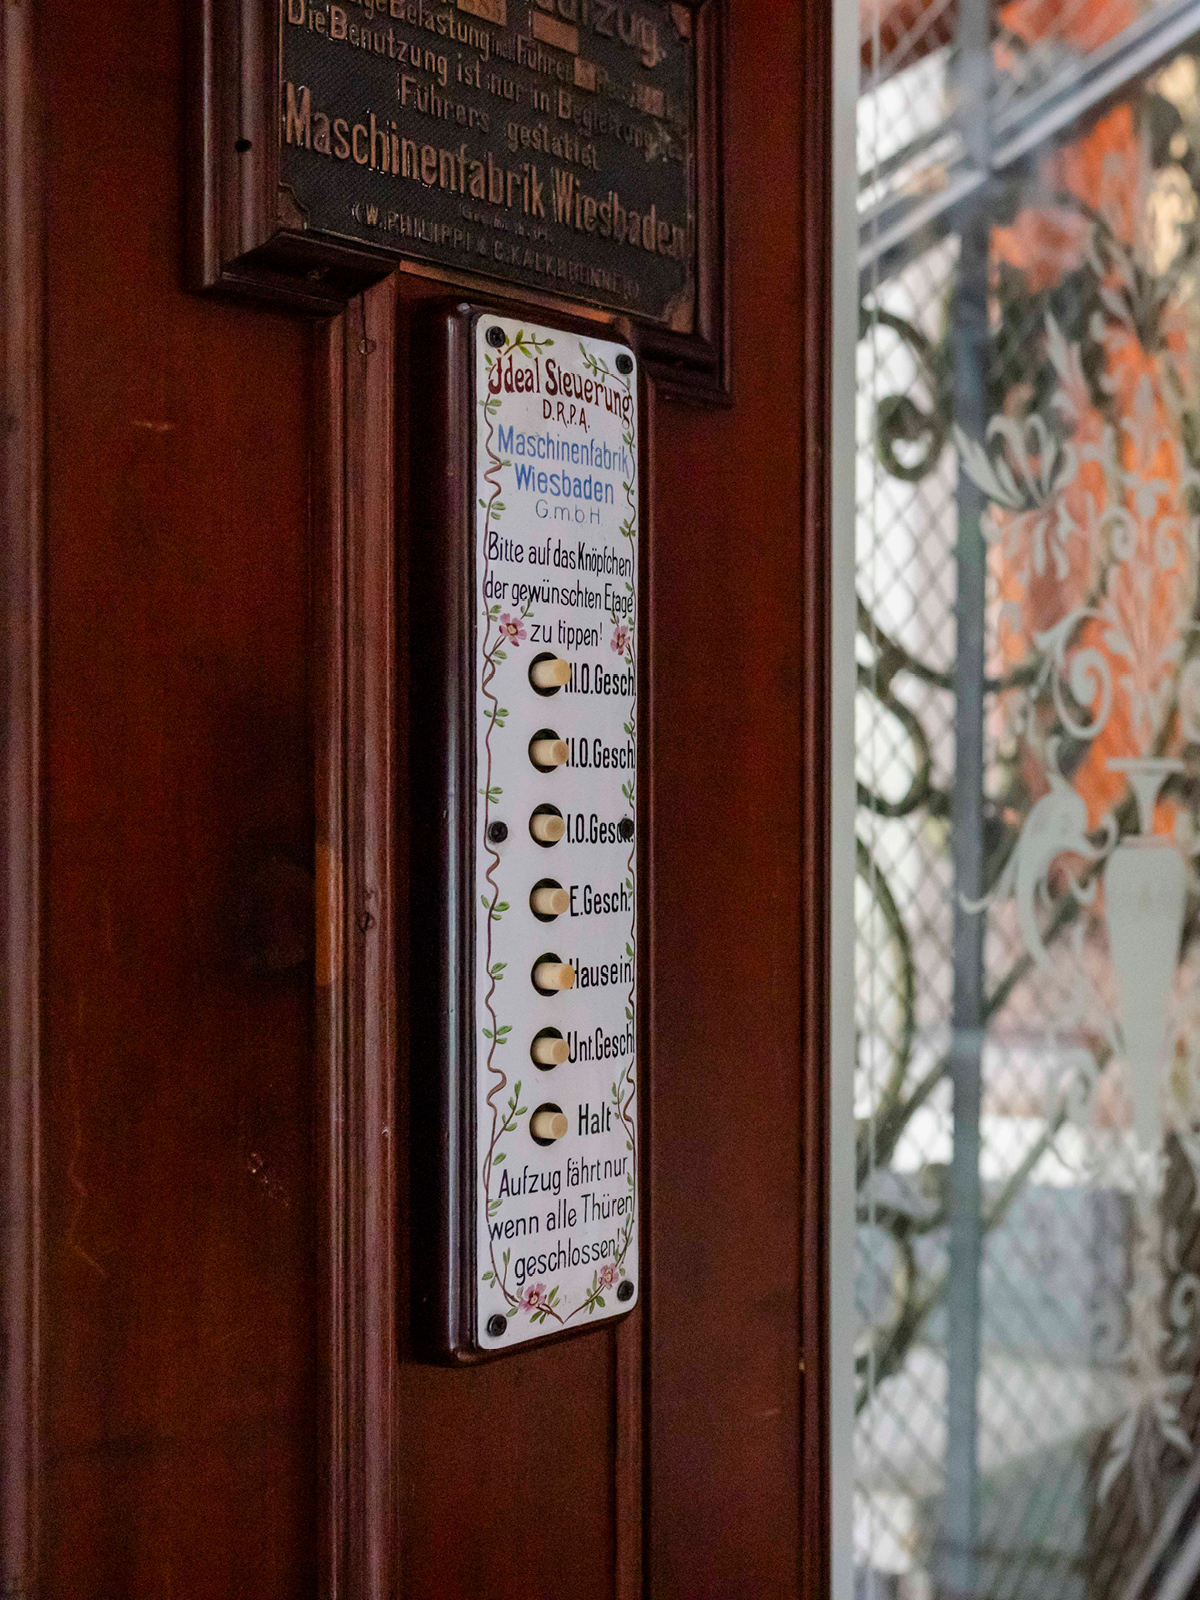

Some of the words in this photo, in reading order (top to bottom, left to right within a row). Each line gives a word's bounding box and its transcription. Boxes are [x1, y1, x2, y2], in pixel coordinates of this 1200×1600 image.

[330, 4, 448, 88] Benutzung
[457, 52, 481, 89] ist
[488, 73, 522, 102] nur
[533, 87, 550, 114] in
[399, 74, 489, 134] Führers
[285, 81, 546, 219] Maschinenfabrik
[552, 165, 686, 258] Wiesbaden
[488, 353, 540, 395] Ideal
[545, 358, 633, 430] Steuerung
[542, 398, 591, 434] D.R.P.A.
[498, 423, 630, 479] Maschinenfabrik
[514, 462, 614, 505] Wiesbaden
[488, 531, 524, 564] Bitte
[528, 537, 552, 566] auf
[553, 538, 576, 571] das
[577, 541, 632, 578] Knöpfchen
[484, 570, 509, 600] der
[511, 578, 602, 610] gewünschten
[604, 582, 634, 619] Etage
[529, 623, 553, 644] zu
[557, 619, 603, 651] tippen!
[569, 882, 631, 917] E.Gesch.
[578, 1101, 612, 1136] Halt
[498, 1165, 562, 1199] Aufzug
[566, 1156, 602, 1187] fährt
[603, 1156, 629, 1179] nur
[487, 1215, 540, 1242] wenn
[546, 1198, 577, 1232] alle
[581, 1192, 634, 1223] Thüren
